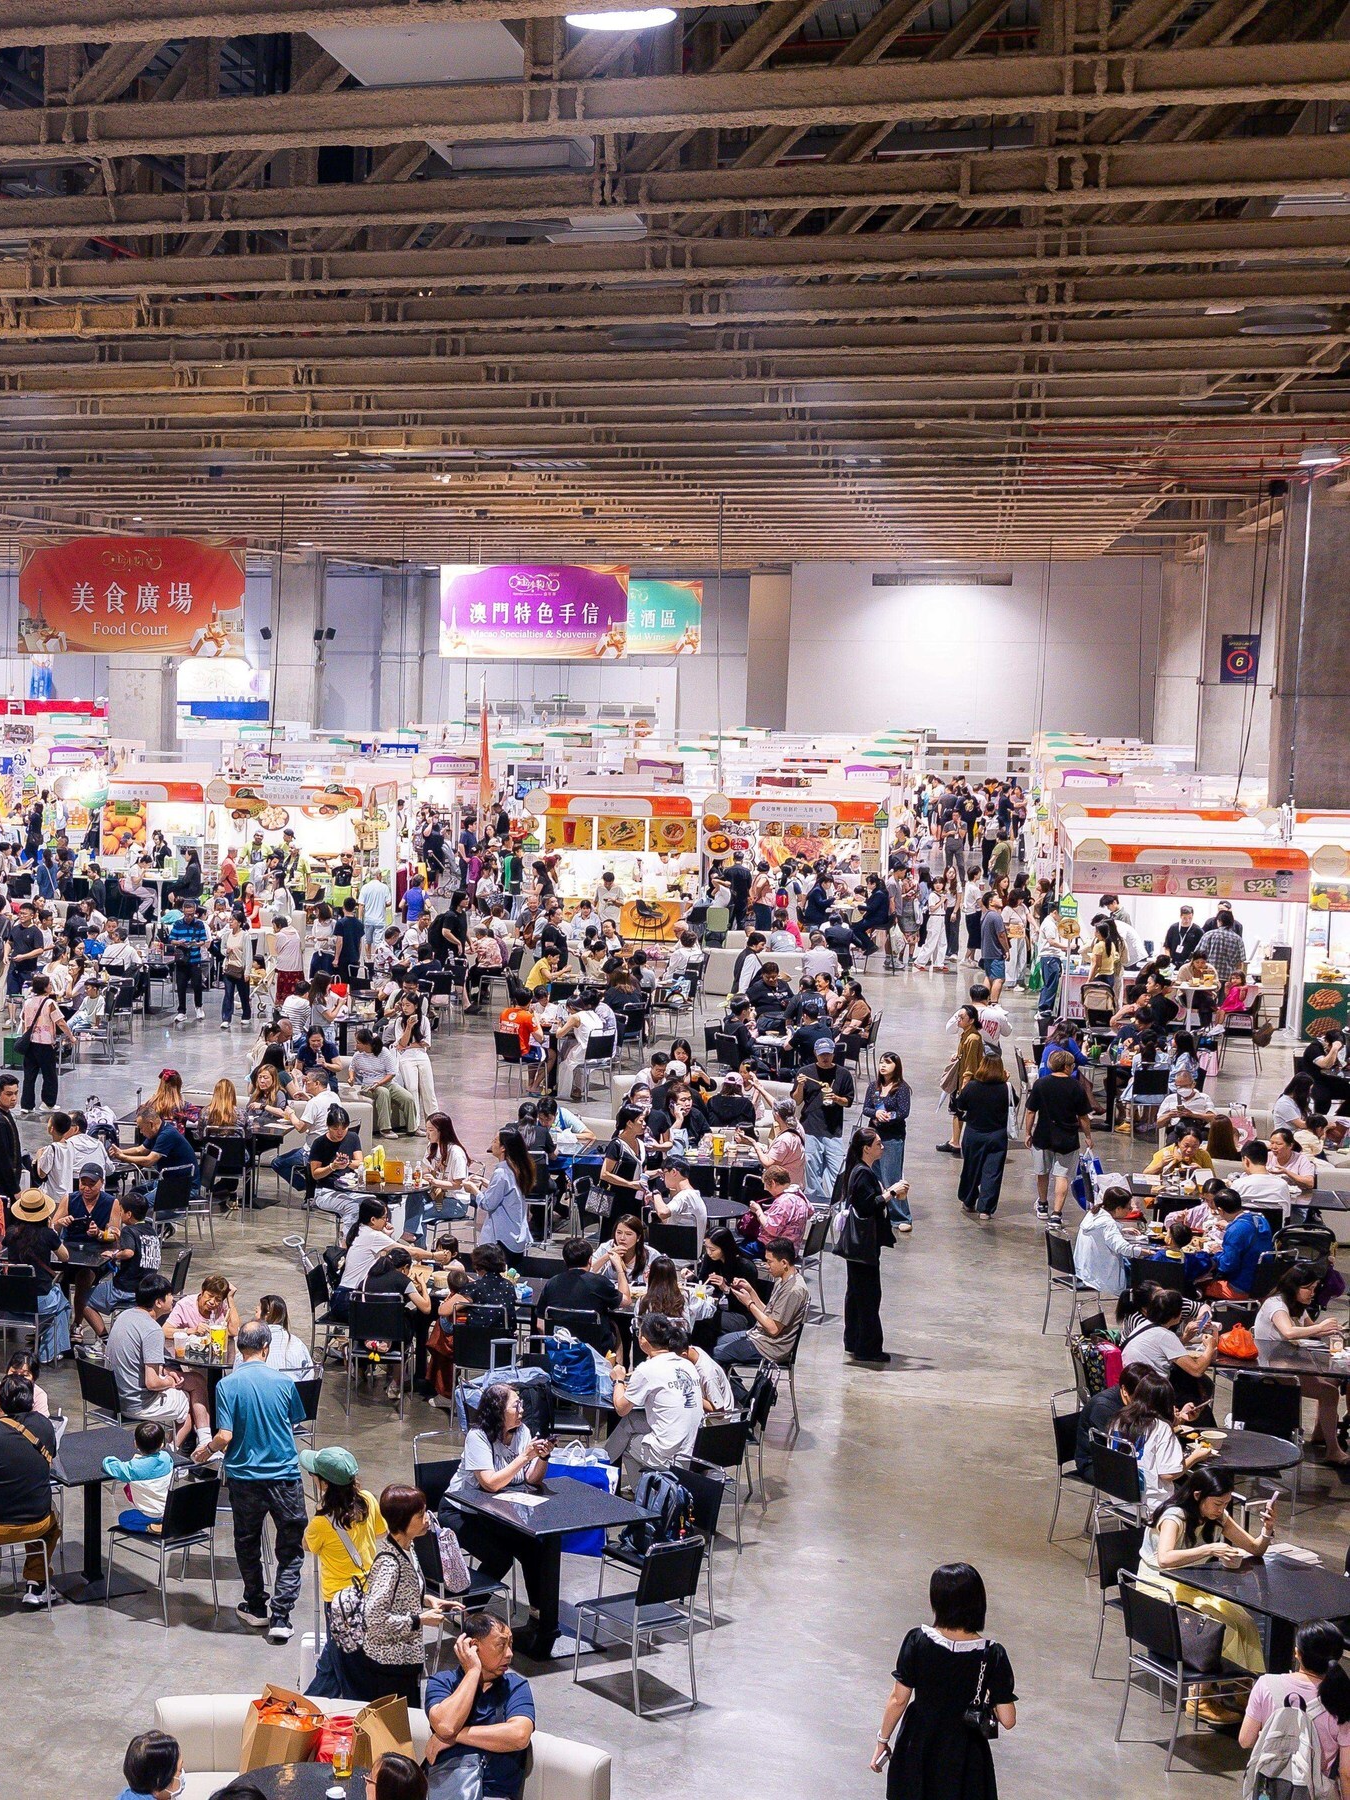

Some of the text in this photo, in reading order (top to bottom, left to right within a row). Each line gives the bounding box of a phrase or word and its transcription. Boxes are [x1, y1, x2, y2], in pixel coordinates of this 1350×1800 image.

[69, 581, 194, 615] 美食廣場
[469, 601, 600, 625] 澳門特色手信
[92, 621, 169, 636] Food Court
[470, 629, 597, 640] Macao Specialties & Souvenirs
[1235, 657, 1244, 667] 6
[262, 773, 303, 782] WOODLANDS
[1126, 874, 1153, 887] $38
[1190, 877, 1216, 890] $32
[1246, 880, 1275, 892] $28
[1063, 924, 1075, 935] $1
